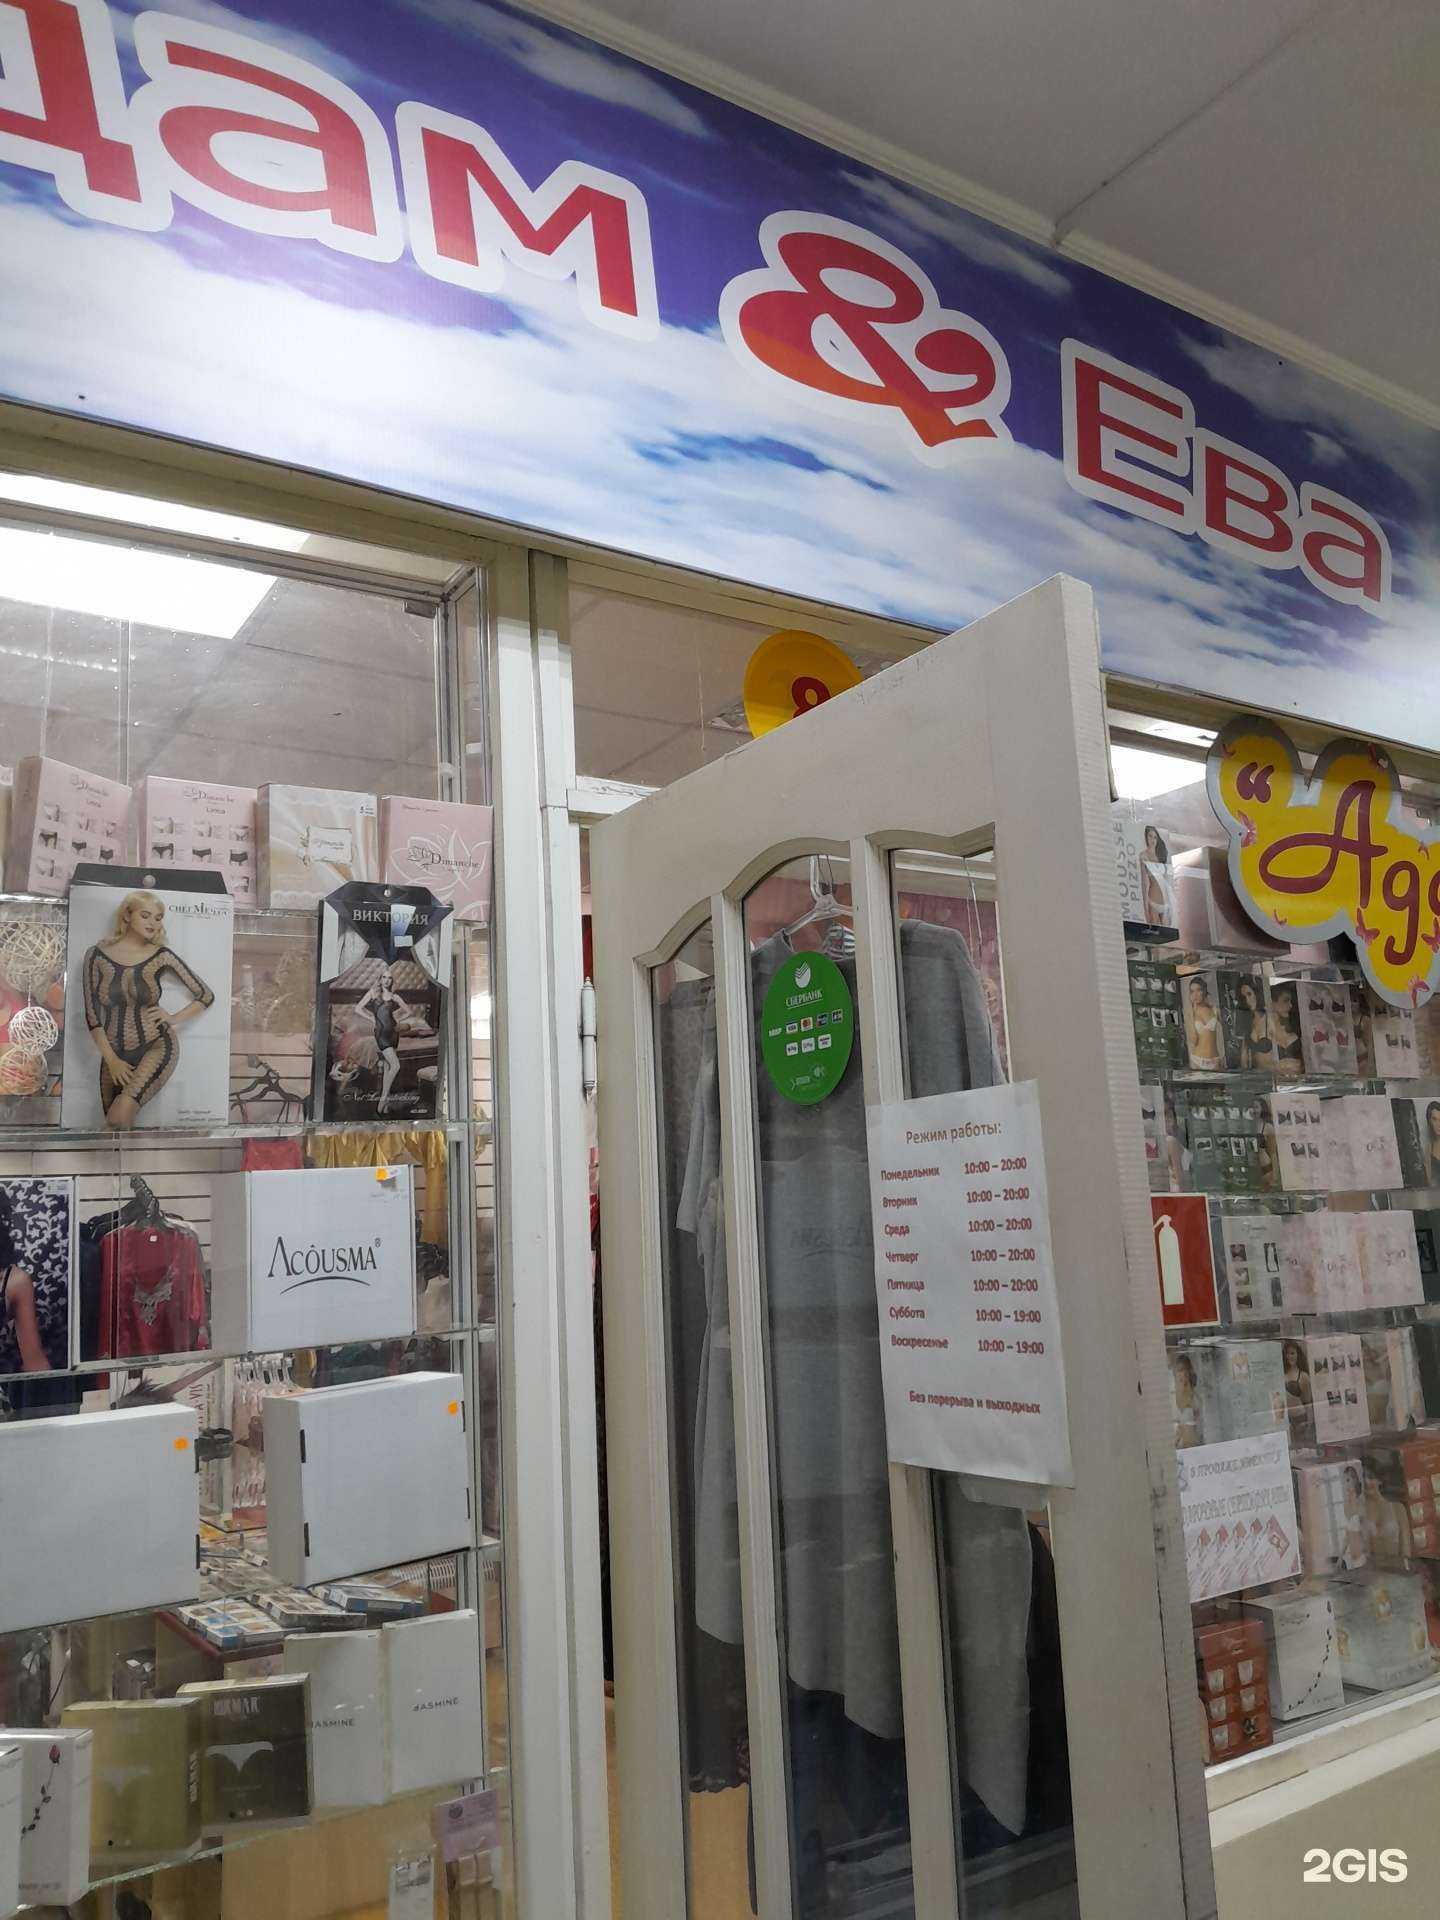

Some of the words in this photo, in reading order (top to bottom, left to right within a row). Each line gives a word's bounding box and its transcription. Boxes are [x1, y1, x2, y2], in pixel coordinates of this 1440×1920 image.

[735, 228, 1000, 450] &
[1070, 350, 1388, 608] Ева
[352, 909, 430, 925] ВИКТОРИЯ
[906, 1129, 947, 1144] Режим
[950, 1122, 1002, 1143] работы:
[964, 1160, 990, 1175] 10:00
[1001, 1157, 1027, 1171] 20:00
[966, 1190, 992, 1203] 10:00
[1003, 1187, 1030, 1200] 20:00
[884, 1224, 910, 1237] Среда
[968, 1219, 994, 1233] 10:00
[1006, 1217, 1032, 1231] 20:00
[970, 1249, 997, 1262] 10:00
[1008, 1248, 1036, 1262] 20:00
[973, 1279, 1000, 1291] 10:00
[1010, 1279, 1038, 1292] 20:00
[889, 1306, 925, 1320] Суббота
[975, 1309, 1002, 1322] 10:00
[1013, 1310, 1041, 1323] 19:00
[978, 1340, 1005, 1352] 10:00
[1016, 1341, 1045, 1354] 19:00
[909, 1390, 925, 1403] Без
